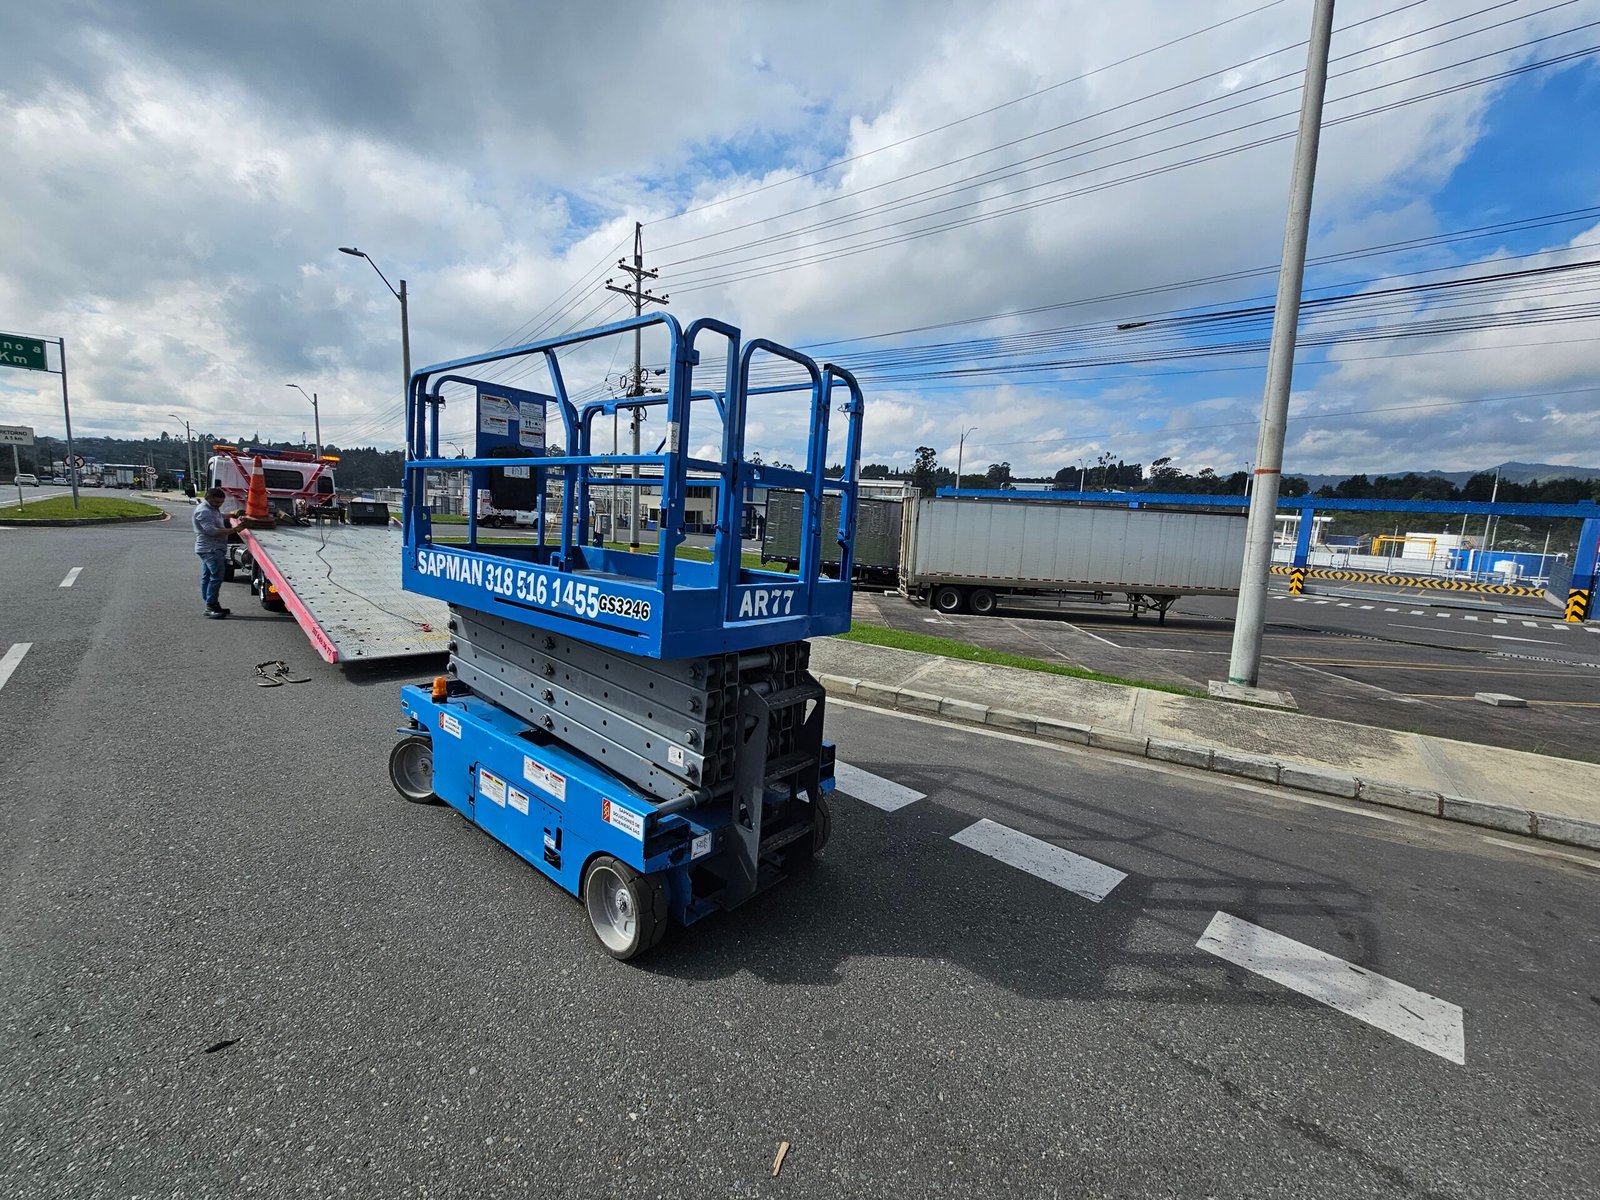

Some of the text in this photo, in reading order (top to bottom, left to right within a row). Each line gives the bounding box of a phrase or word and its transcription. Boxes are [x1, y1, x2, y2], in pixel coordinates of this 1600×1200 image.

[0, 341, 42, 354] no a
[418, 551, 600, 618] SAPMAN 318 516 1455
[598, 595, 651, 621] GS3246
[739, 589, 794, 617] AR77
